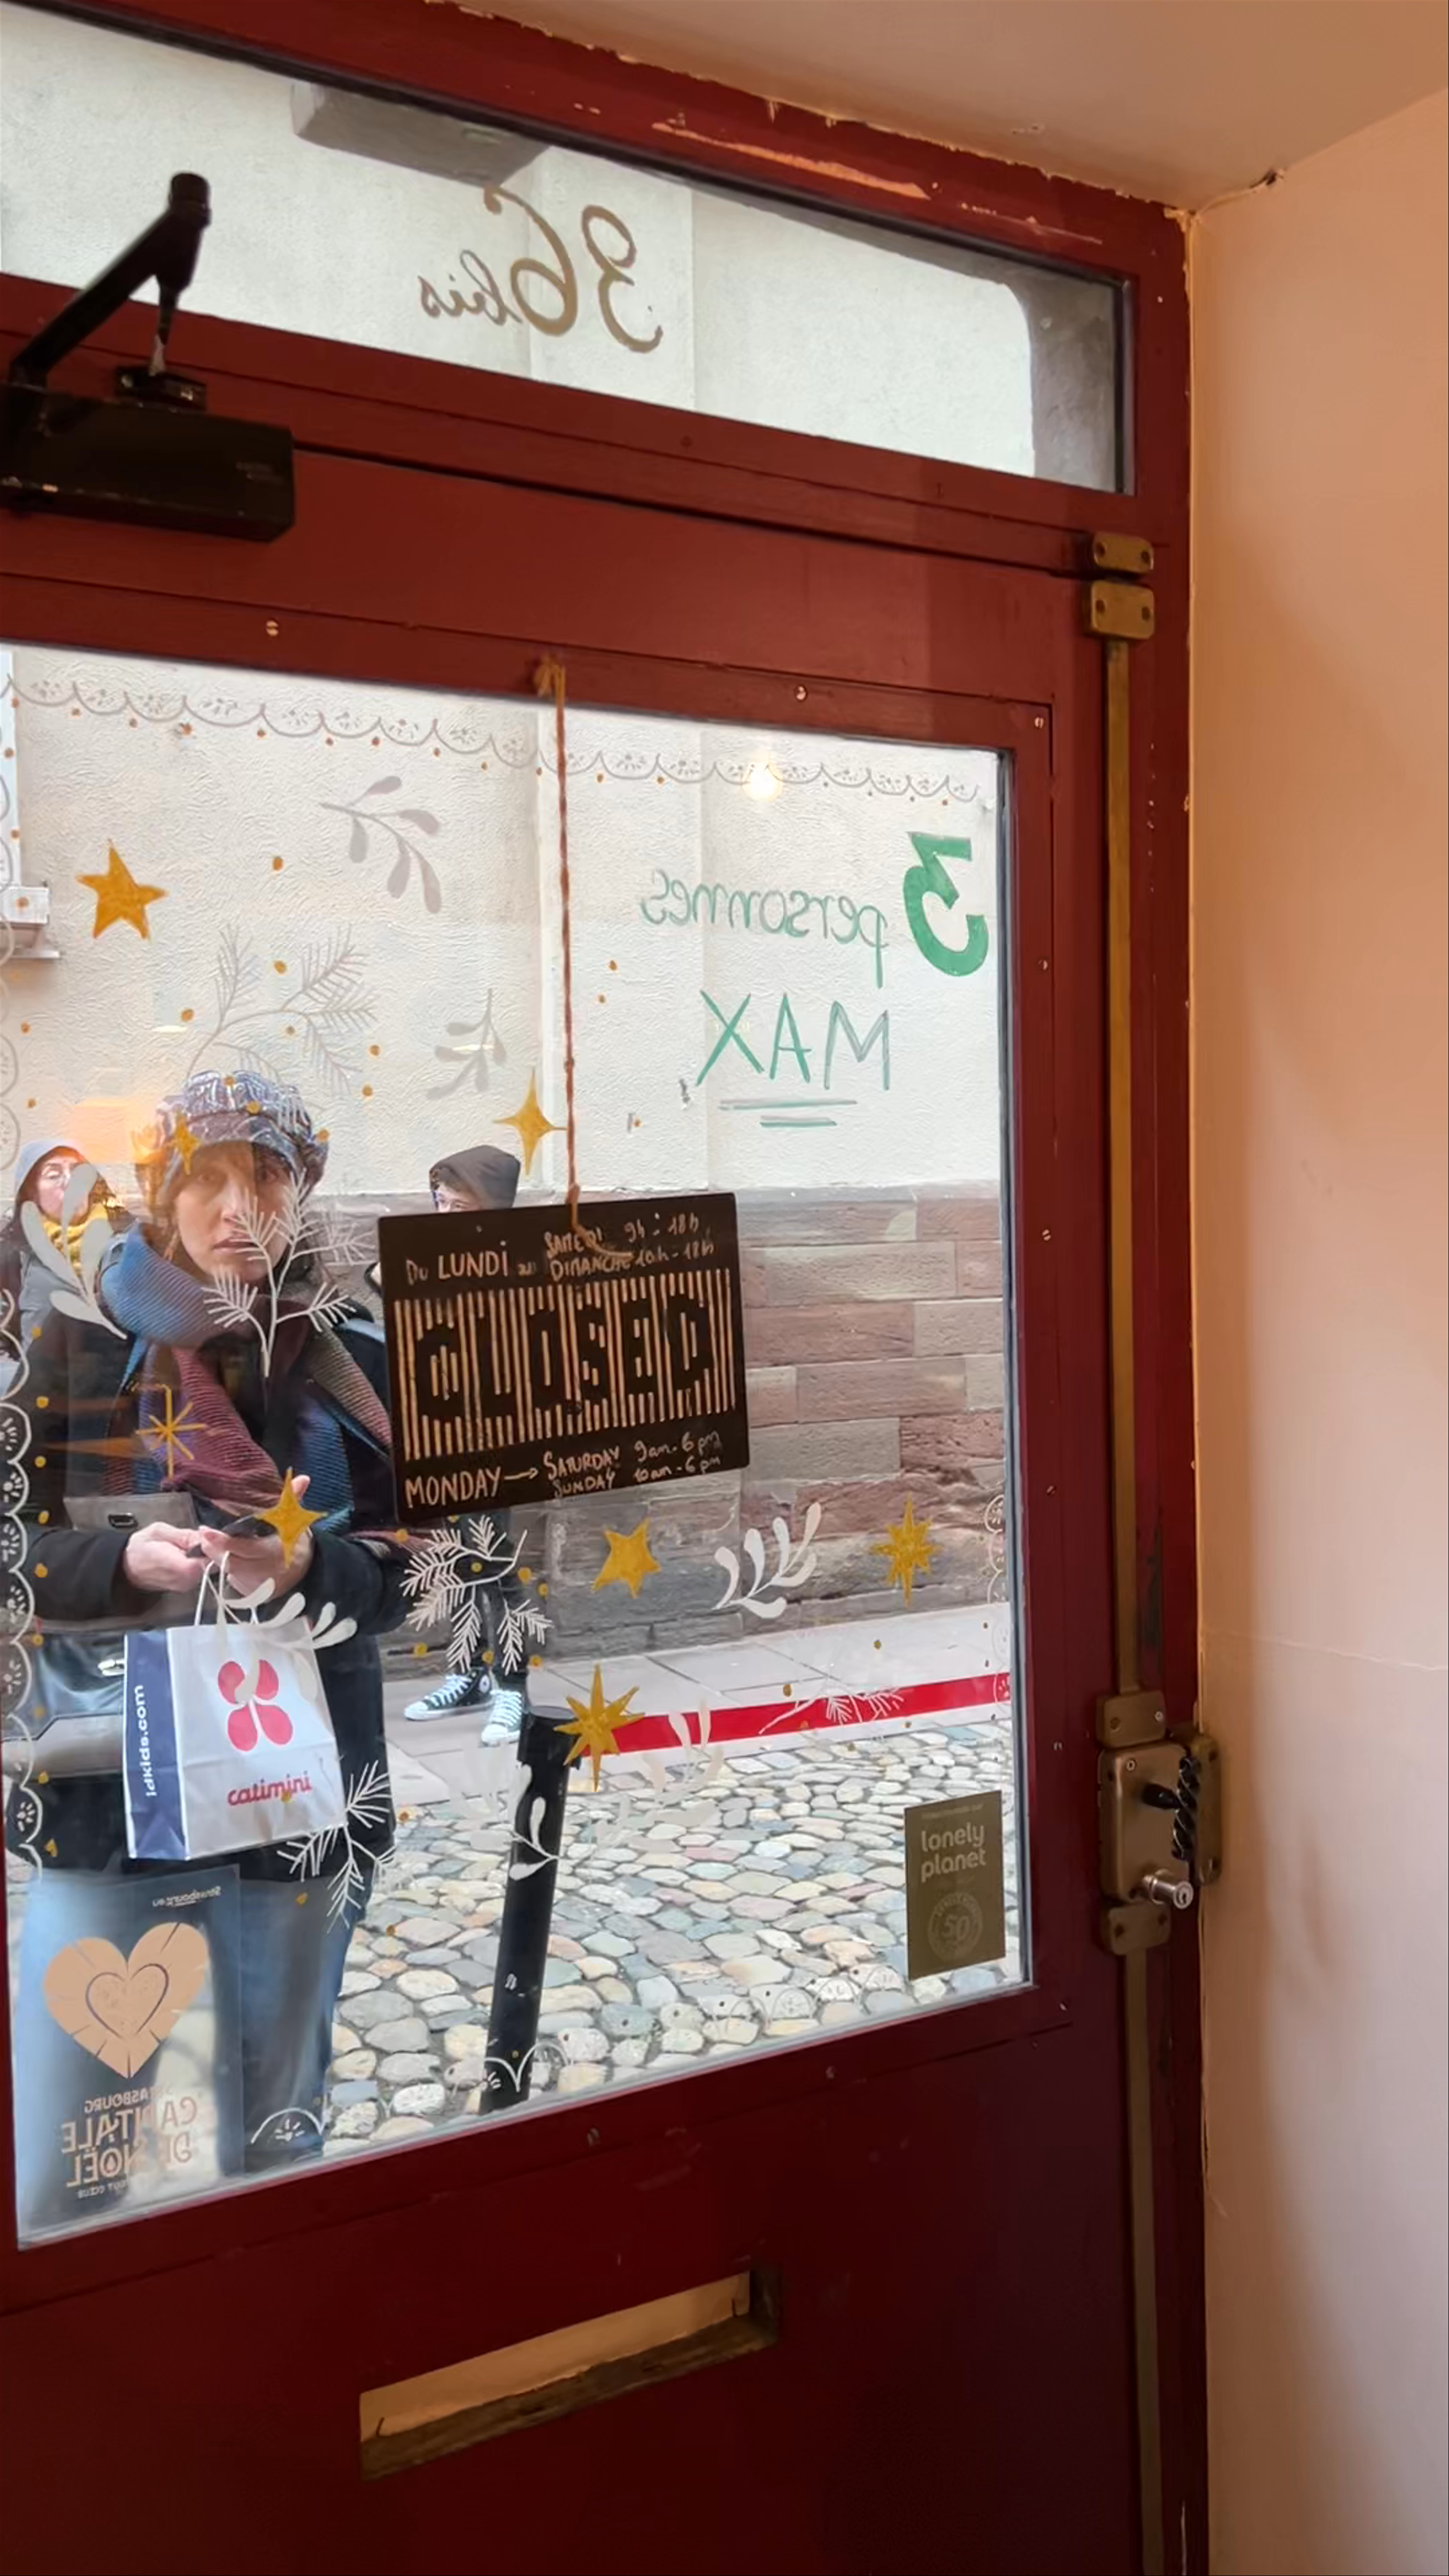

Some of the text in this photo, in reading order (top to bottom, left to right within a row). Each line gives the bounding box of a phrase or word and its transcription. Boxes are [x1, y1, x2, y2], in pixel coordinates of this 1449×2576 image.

[438, 1250, 508, 1279] LUNDI
[417, 1292, 714, 1424] CLOSED
[543, 1446, 619, 1480] SATURDAY
[405, 1466, 501, 1508] MONDAY
[552, 1468, 615, 1498] SUNDAY
[228, 1770, 312, 1806] catimini
[921, 1822, 984, 1852] lonely
[921, 1848, 987, 1883] planet
